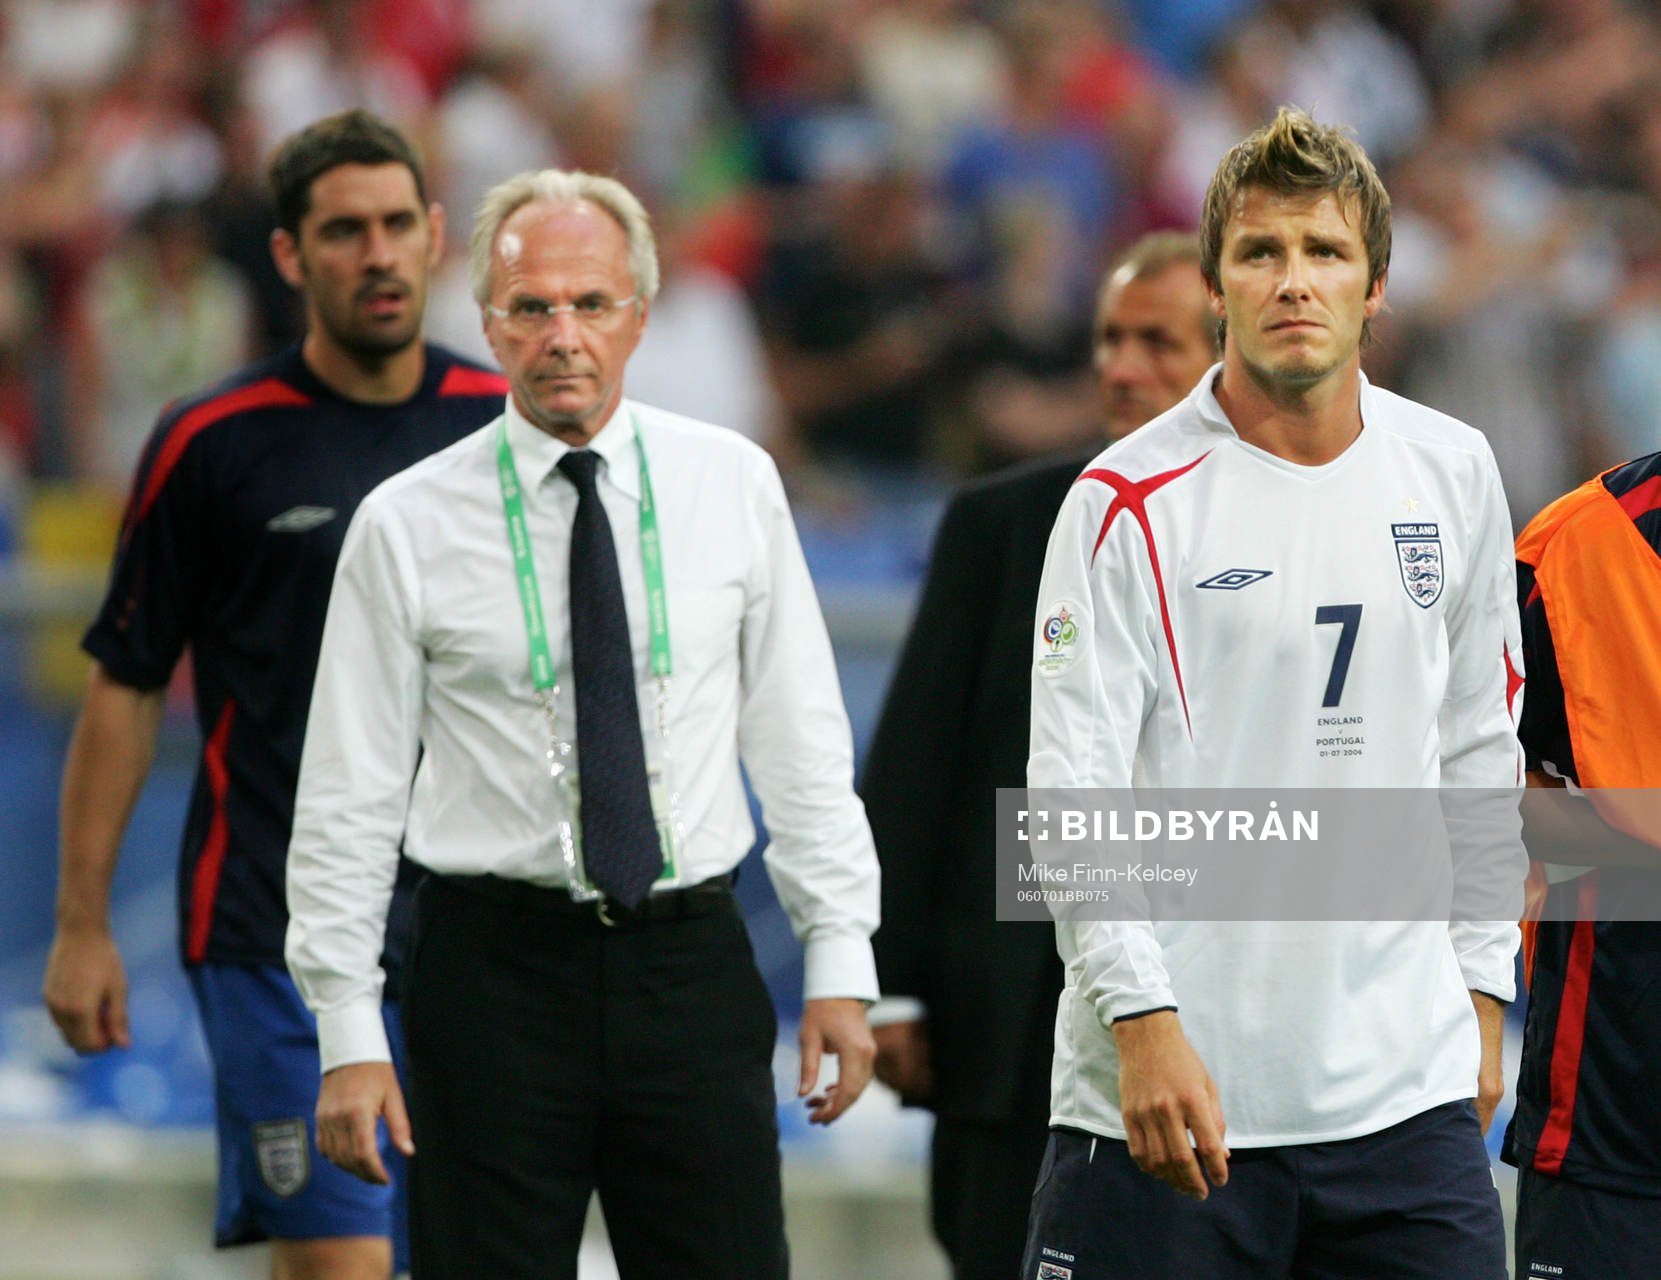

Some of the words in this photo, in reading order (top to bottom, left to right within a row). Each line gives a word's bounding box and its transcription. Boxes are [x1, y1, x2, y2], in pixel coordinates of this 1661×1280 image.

[1394, 525, 1437, 536] ENGLAND
[1315, 604, 1363, 707] 7
[1317, 716, 1363, 726] ENGLAND
[1316, 736, 1365, 746] PORTUGAL
[1042, 1247, 1075, 1262] ENGLAND
[1531, 1262, 1563, 1274] ENGLAND
